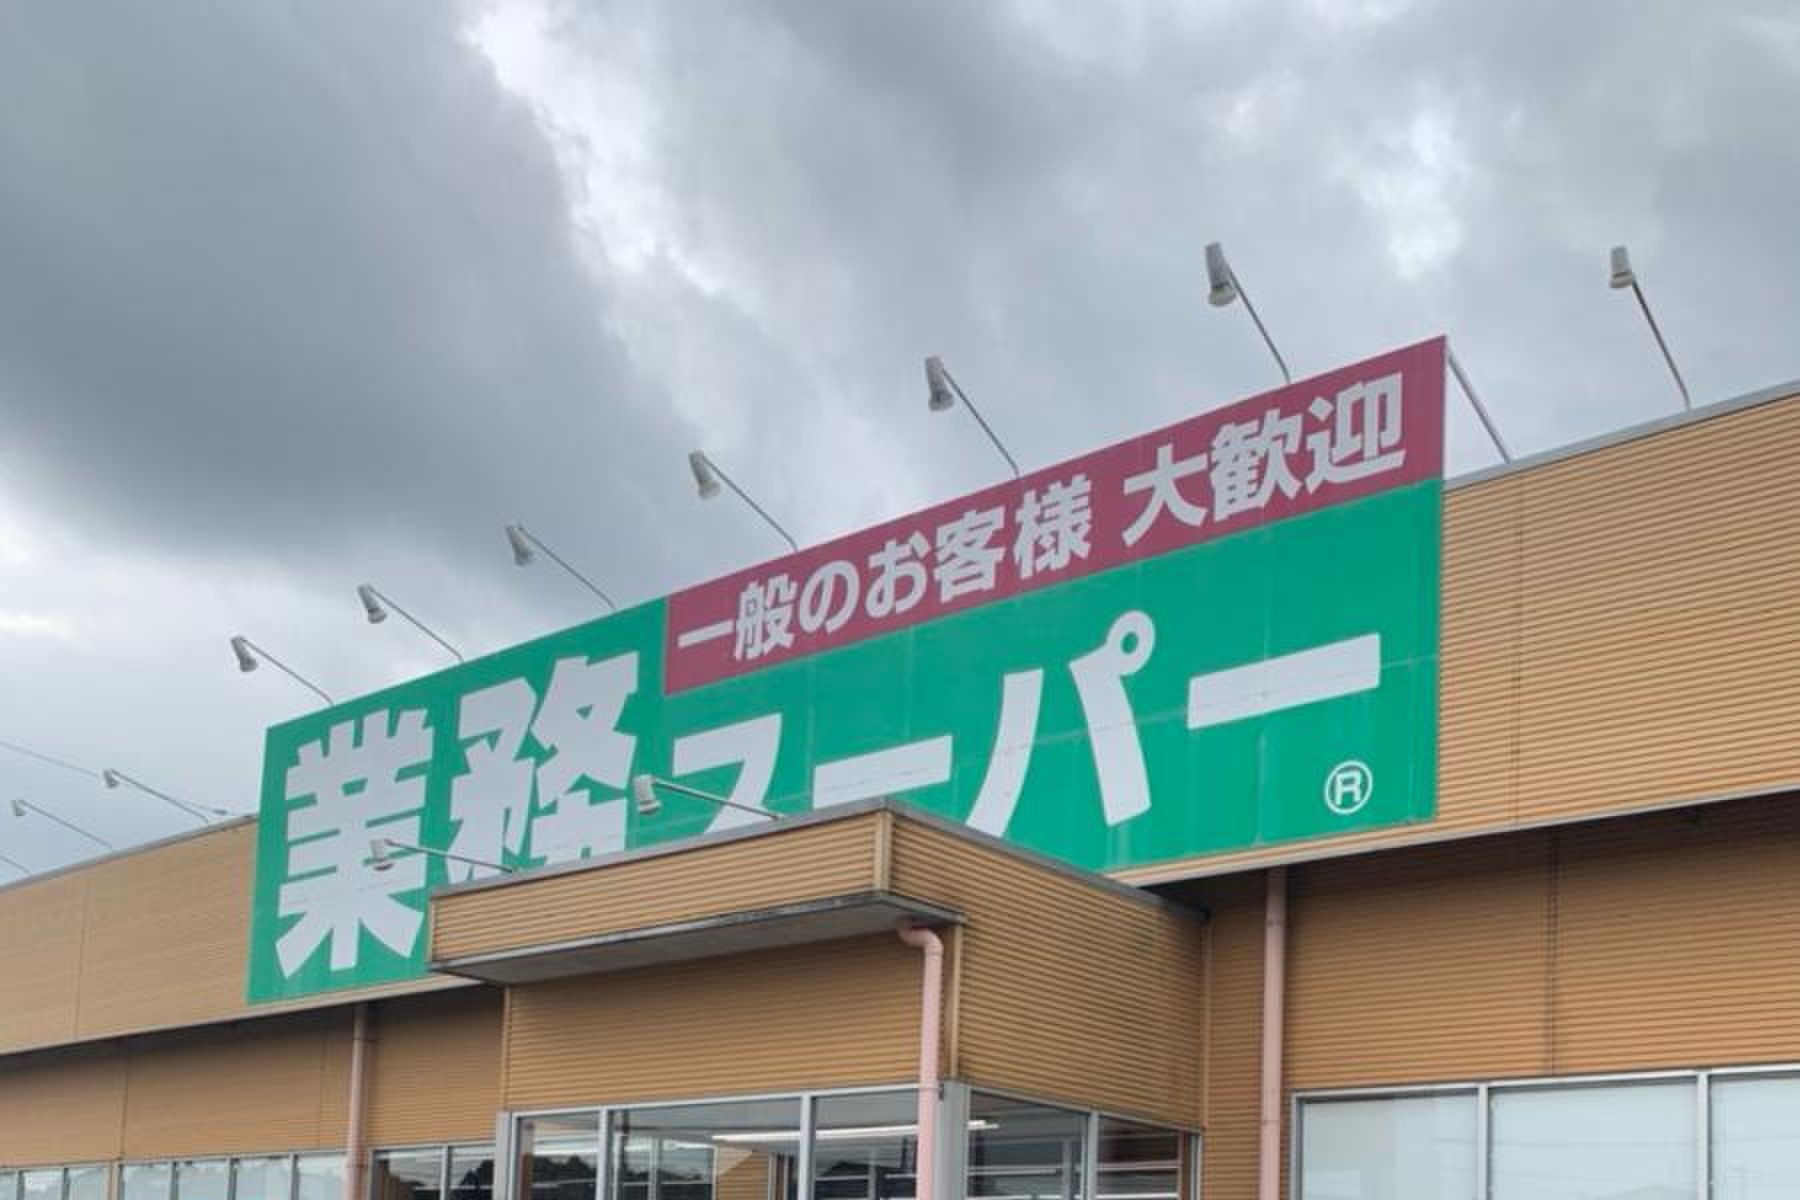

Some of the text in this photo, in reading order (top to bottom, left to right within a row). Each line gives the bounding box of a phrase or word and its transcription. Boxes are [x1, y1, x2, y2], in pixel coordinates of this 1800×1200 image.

[677, 372, 1406, 663] 一般のお客様 大歓迎
[275, 610, 1382, 980] 業務スーパー
